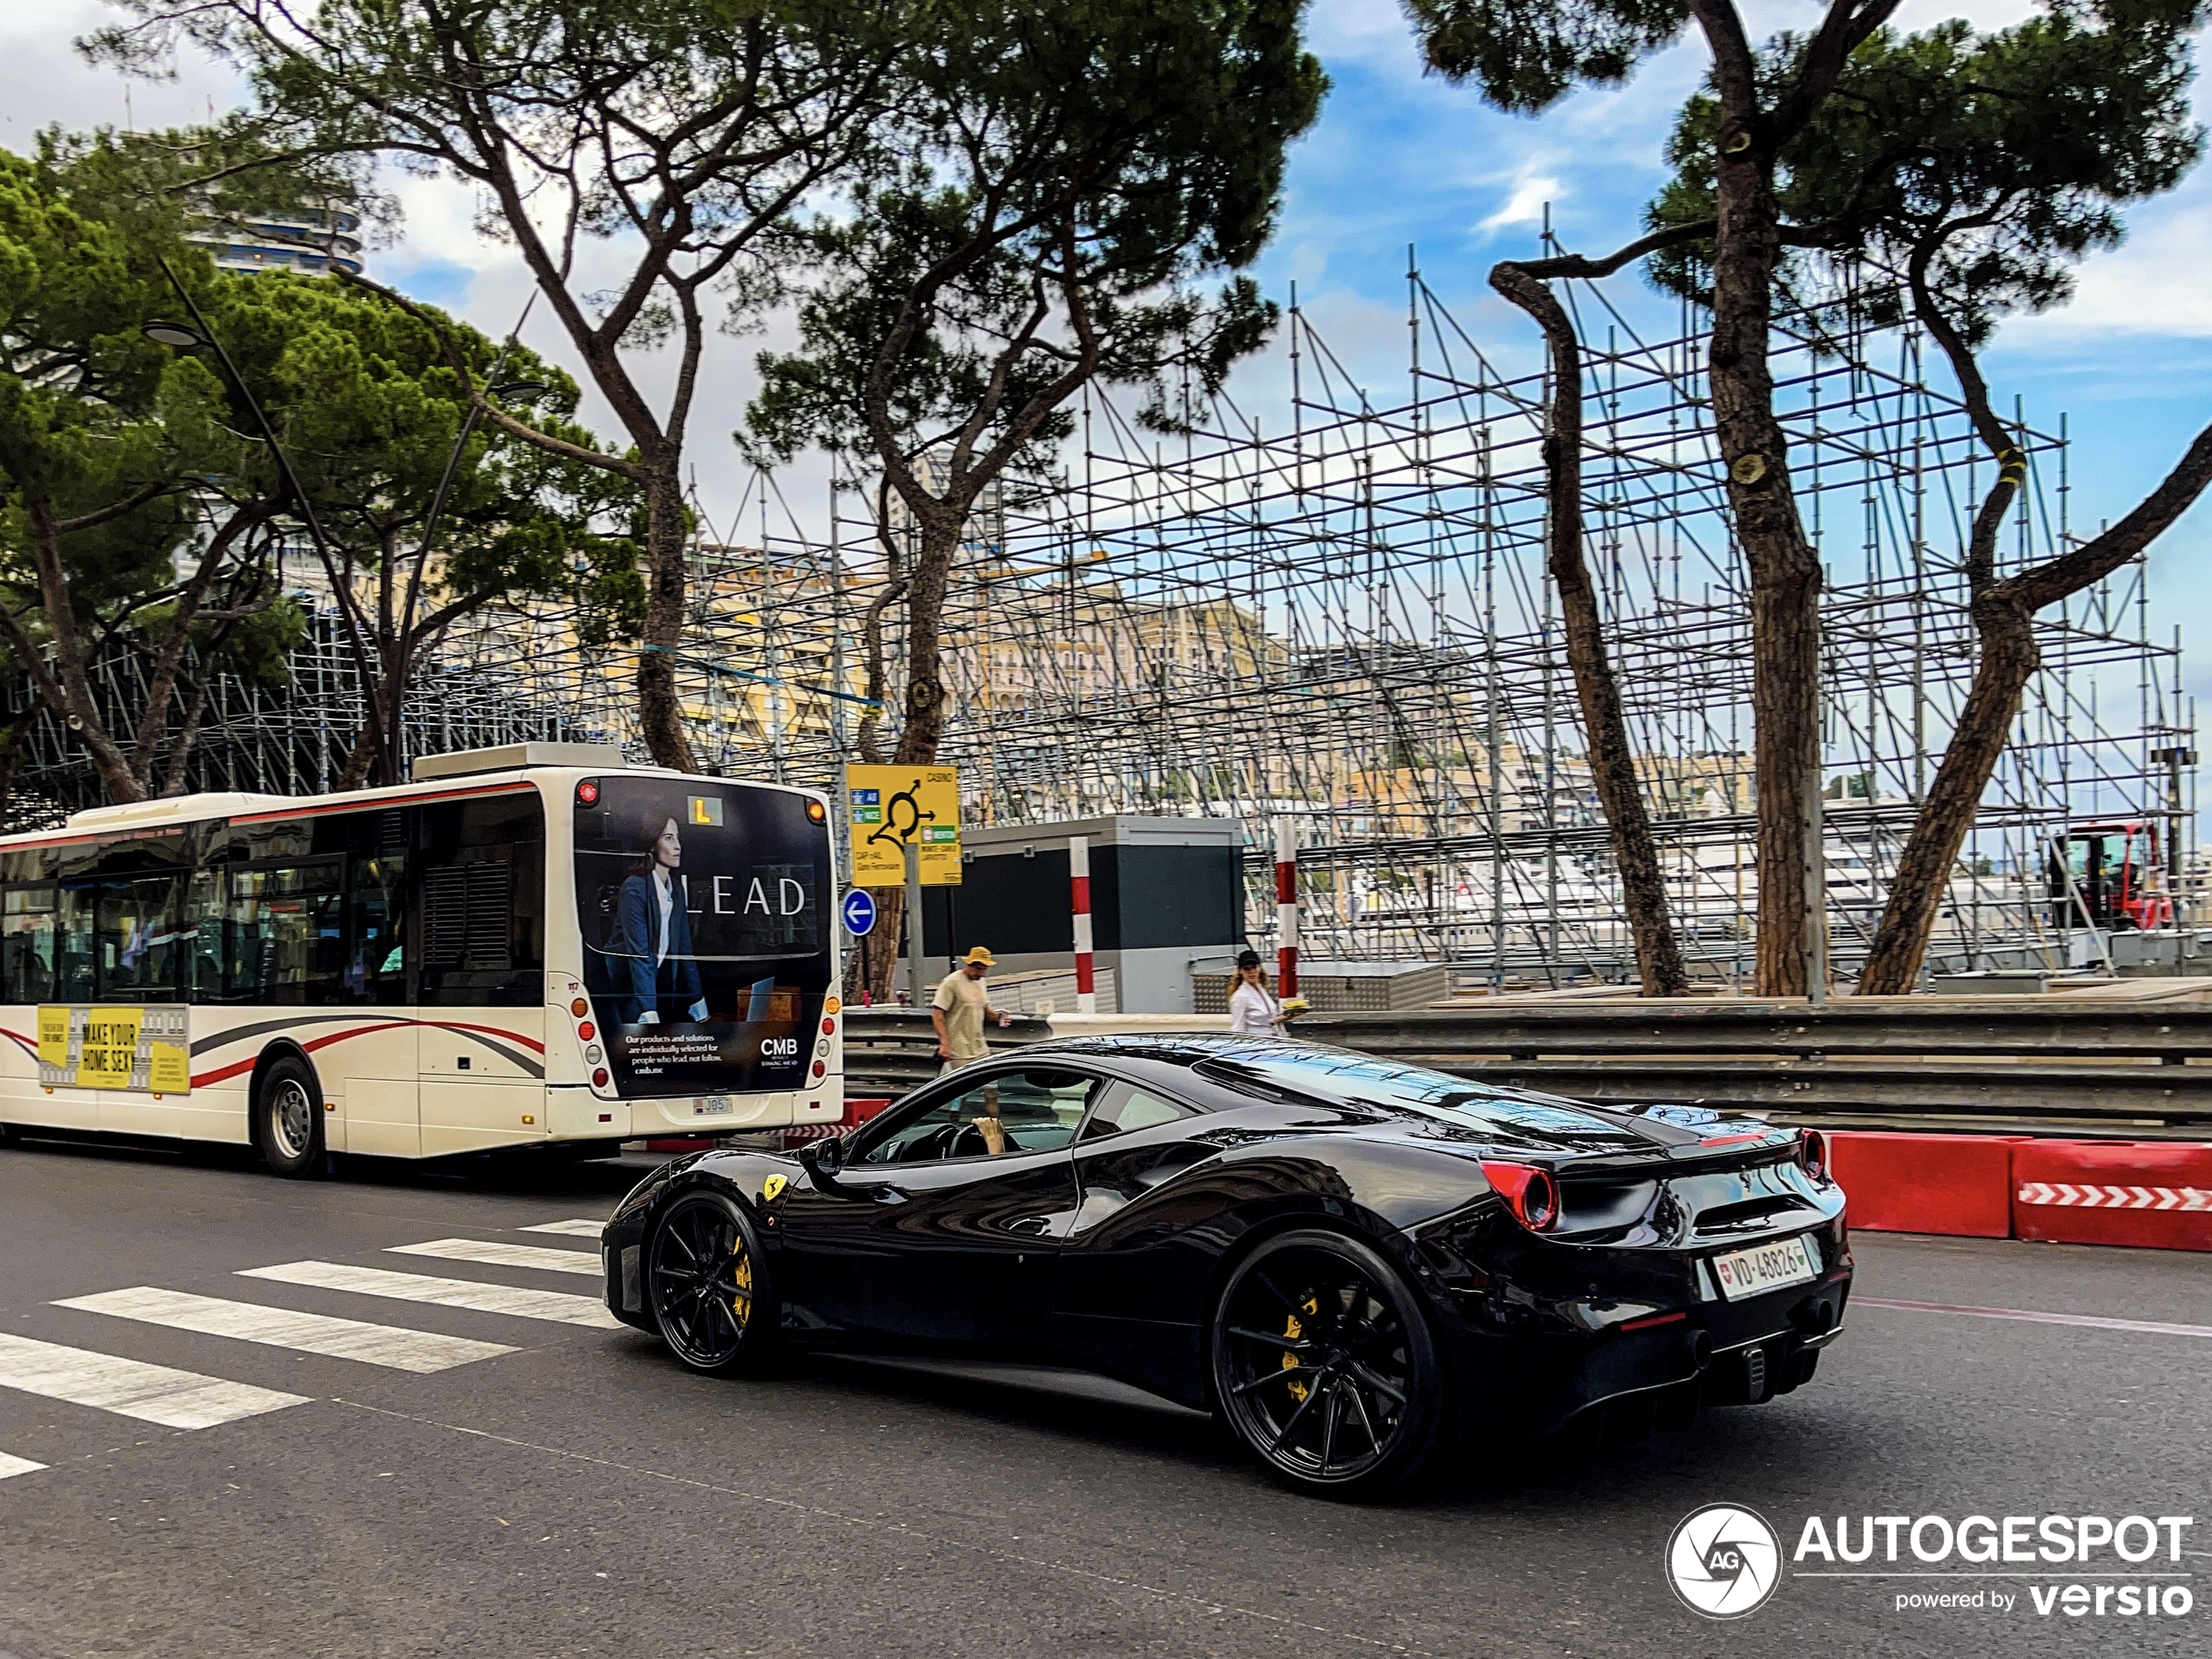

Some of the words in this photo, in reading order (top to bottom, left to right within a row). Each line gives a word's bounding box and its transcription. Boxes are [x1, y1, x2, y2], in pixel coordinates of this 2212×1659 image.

[680, 874, 805, 915] LEAD
[83, 1023, 108, 1045] MAKE
[110, 1023, 137, 1046] YOUR
[640, 1035, 671, 1044] products
[671, 1034, 685, 1042] and
[685, 1034, 714, 1042] solutions
[642, 1044, 679, 1055] individually
[680, 1043, 707, 1052] selected
[760, 1038, 798, 1055] CMB
[83, 1049, 108, 1071] HOME
[111, 1049, 135, 1072] SEXY
[632, 1055, 656, 1065] people
